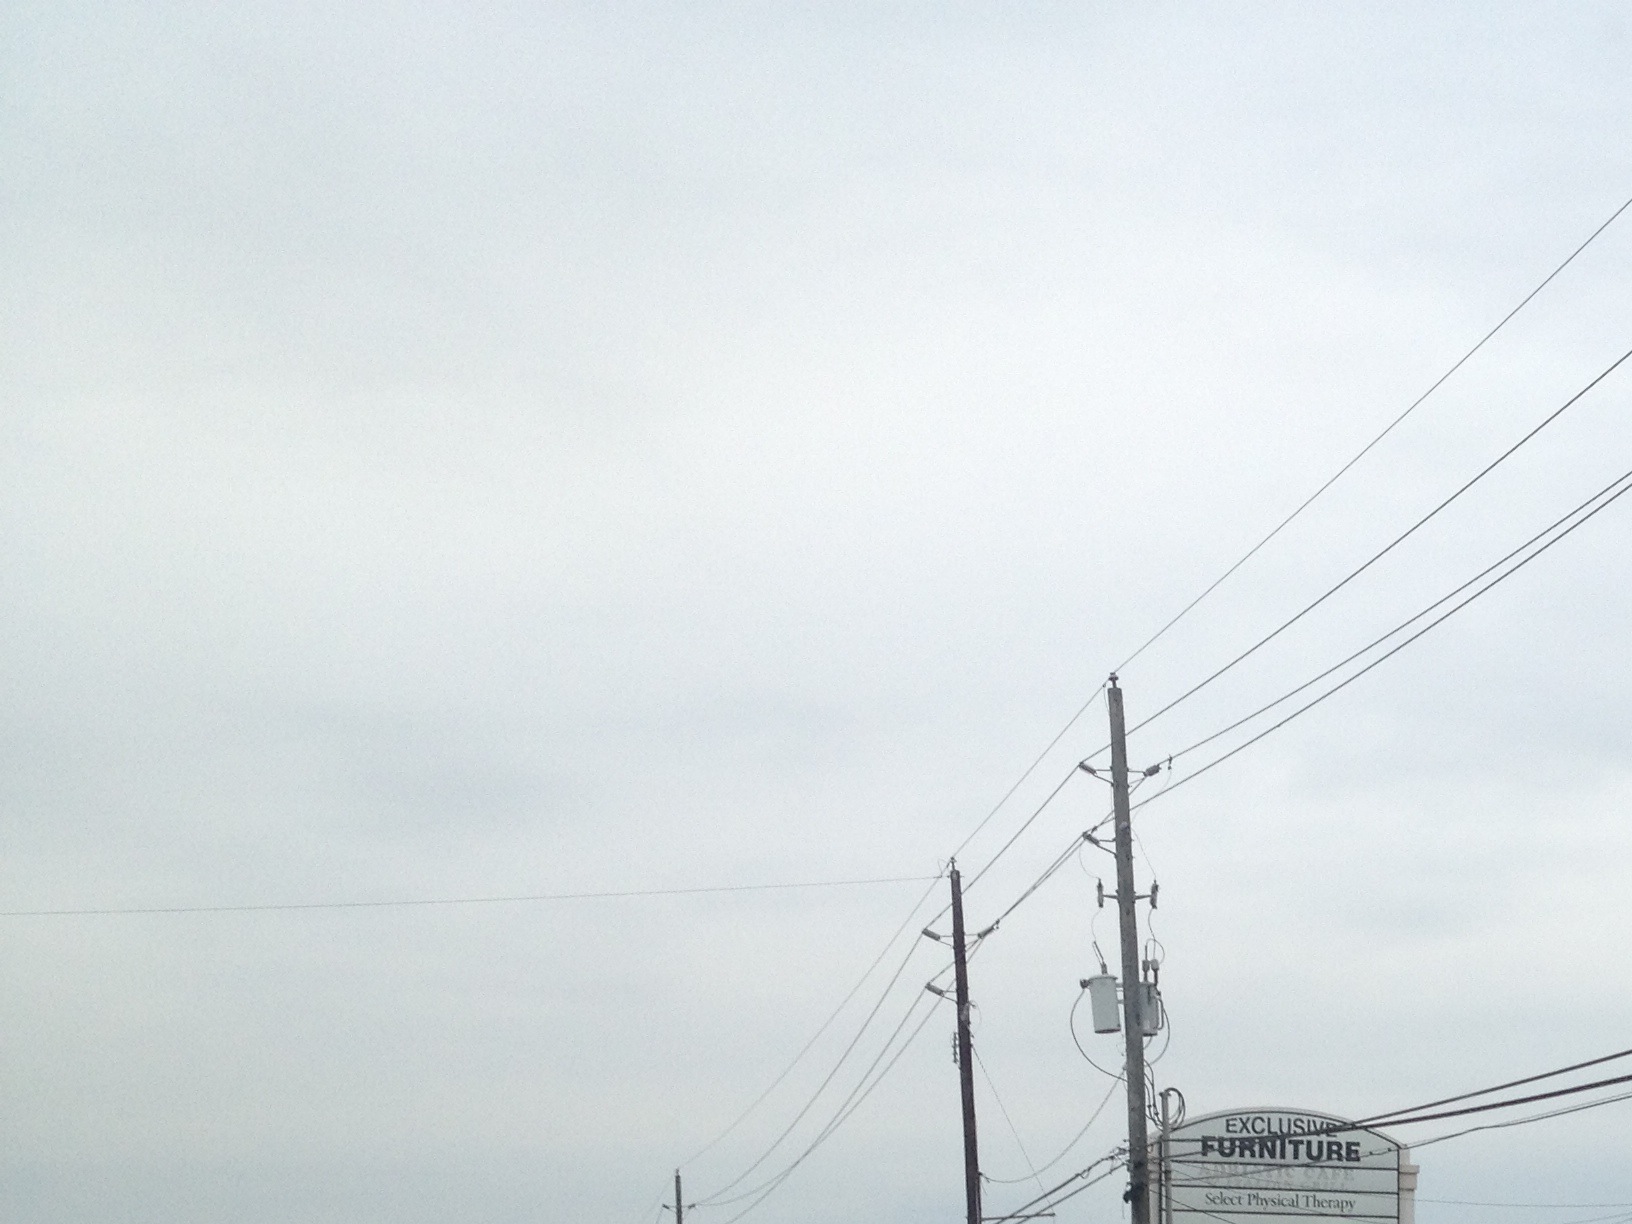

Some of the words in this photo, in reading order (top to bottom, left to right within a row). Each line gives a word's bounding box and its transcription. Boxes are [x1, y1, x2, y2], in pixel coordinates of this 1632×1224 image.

[1225, 1116, 1337, 1138] EXCLUSIVE
[1201, 1136, 1361, 1162] FURNITURE
[1205, 1191, 1243, 1207] Select
[1247, 1193, 1300, 1210] Physical
[1302, 1194, 1356, 1213] Therapy
